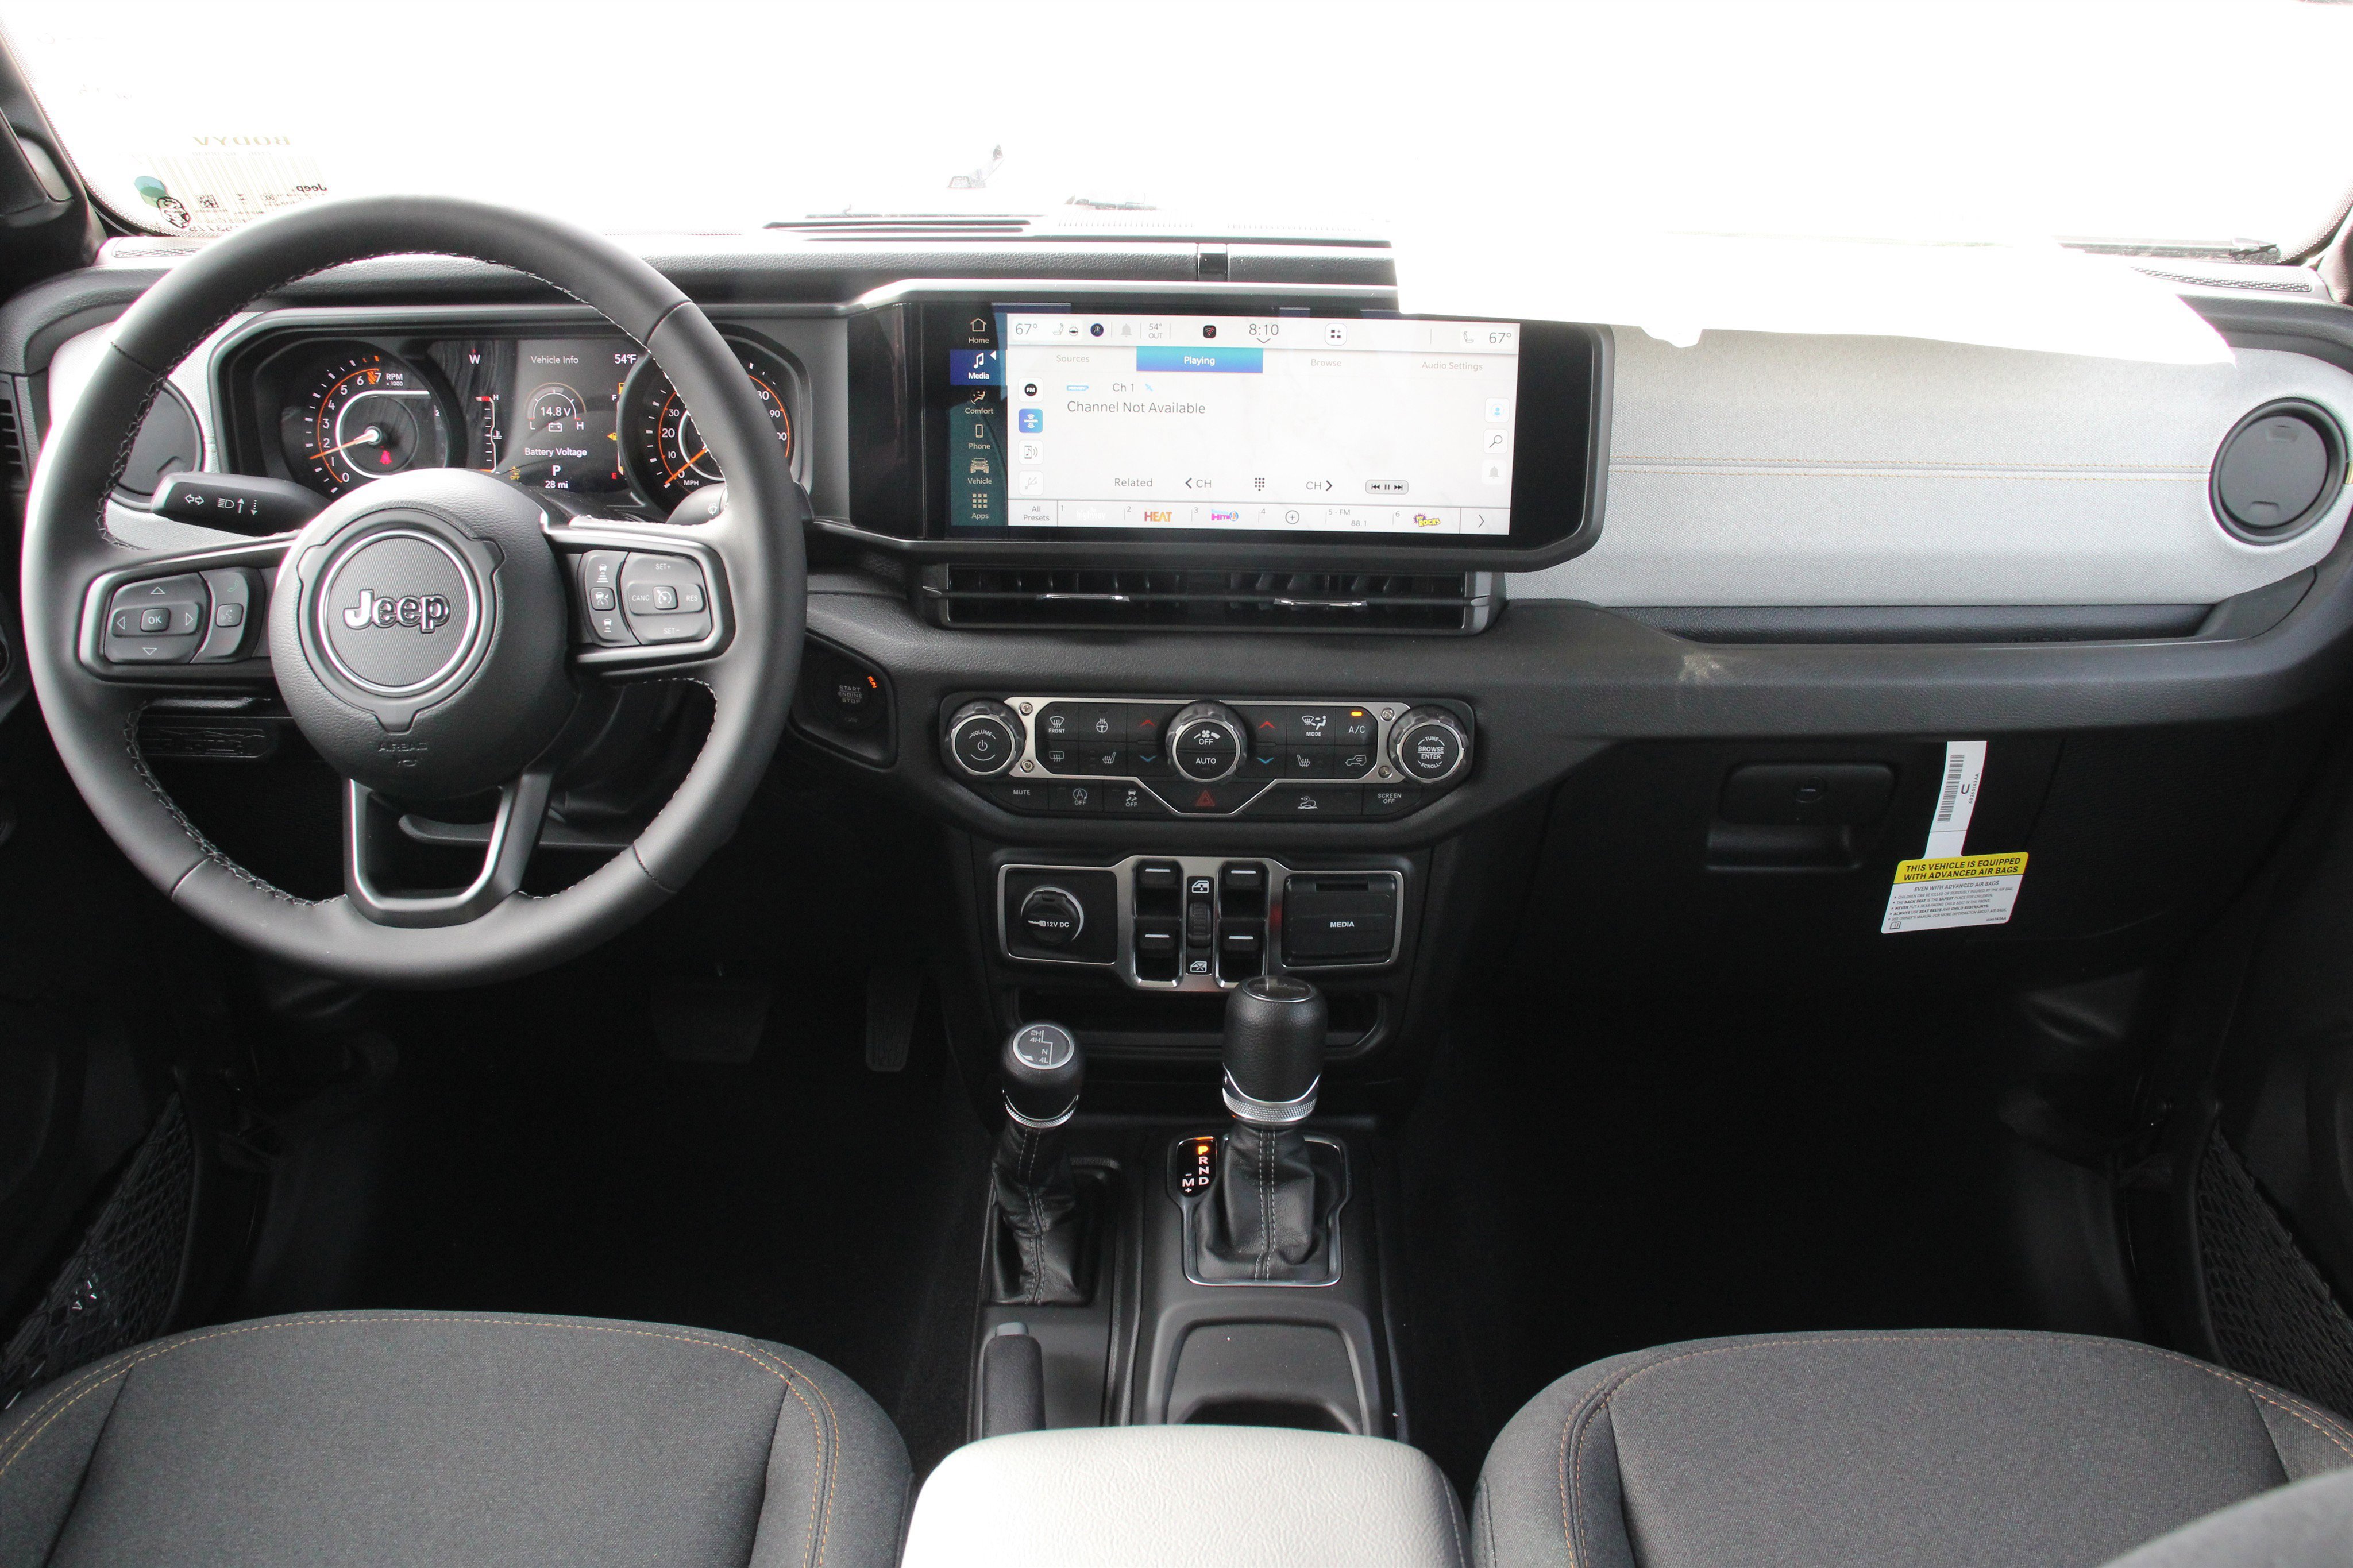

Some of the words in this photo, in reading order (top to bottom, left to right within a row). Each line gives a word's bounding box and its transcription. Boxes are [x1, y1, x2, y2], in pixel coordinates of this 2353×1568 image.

[1015, 323, 1038, 336] 67°
[1249, 323, 1279, 337] 8:10
[1488, 331, 1512, 344] 67°
[469, 354, 480, 364] W
[531, 356, 561, 364] Vehicle
[563, 356, 579, 364] Info
[615, 354, 637, 364] 54°F
[1056, 354, 1090, 363] Sources
[1183, 356, 1216, 367] Playing
[1310, 358, 1342, 368] Browse
[1421, 361, 1447, 370] Audio
[1449, 362, 1483, 372] Settings
[357, 376, 364, 385] 6
[375, 372, 381, 383] 7
[340, 385, 348, 395] 5
[1112, 383, 1127, 392] Ch
[1131, 383, 1135, 392] 1
[328, 400, 335, 410] 4
[1067, 401, 1118, 414] Channel
[1123, 402, 1145, 414] Not
[1148, 402, 1206, 414] Available
[541, 407, 562, 416] 14.8
[564, 407, 571, 416] V
[668, 409, 680, 417] 30
[769, 410, 780, 418] 90
[965, 407, 994, 415] Comfort
[323, 418, 330, 429] 3
[530, 421, 535, 430] L
[576, 421, 584, 430] H
[662, 428, 675, 438] 20
[323, 438, 330, 449] 2
[524, 447, 554, 457] Battery
[556, 447, 588, 458] Voltage
[668, 451, 676, 459] 10
[331, 456, 335, 466] 1
[552, 465, 561, 476] P
[678, 469, 685, 478] 0
[342, 472, 350, 482] 0
[545, 481, 556, 489] 28
[558, 480, 569, 489] mi
[1114, 478, 1153, 488] Related
[1195, 479, 1212, 488] CH
[1306, 481, 1322, 491] CH
[971, 512, 989, 522] Apps
[1076, 509, 1106, 521] highway
[1144, 511, 1172, 522] HEAT
[1419, 518, 1440, 527] ROCKS
[344, 589, 451, 634] Jeep
[148, 616, 161, 625] OK
[867, 676, 877, 688] RUN
[971, 729, 993, 737] VOLUME
[1348, 725, 1365, 734] A/C
[1961, 783, 1970, 794] U
[1906, 864, 1926, 872] THIS
[1928, 862, 1965, 870] VEHICLE
[1977, 858, 2021, 867] EQUIPPED
[1928, 869, 1977, 879] ADVANCED
[1198, 1146, 1209, 1155] P
[1198, 1156, 1208, 1165] R
[1198, 1166, 1209, 1175] N
[1182, 1178, 1194, 1187] M
[1198, 1177, 1209, 1185] D
